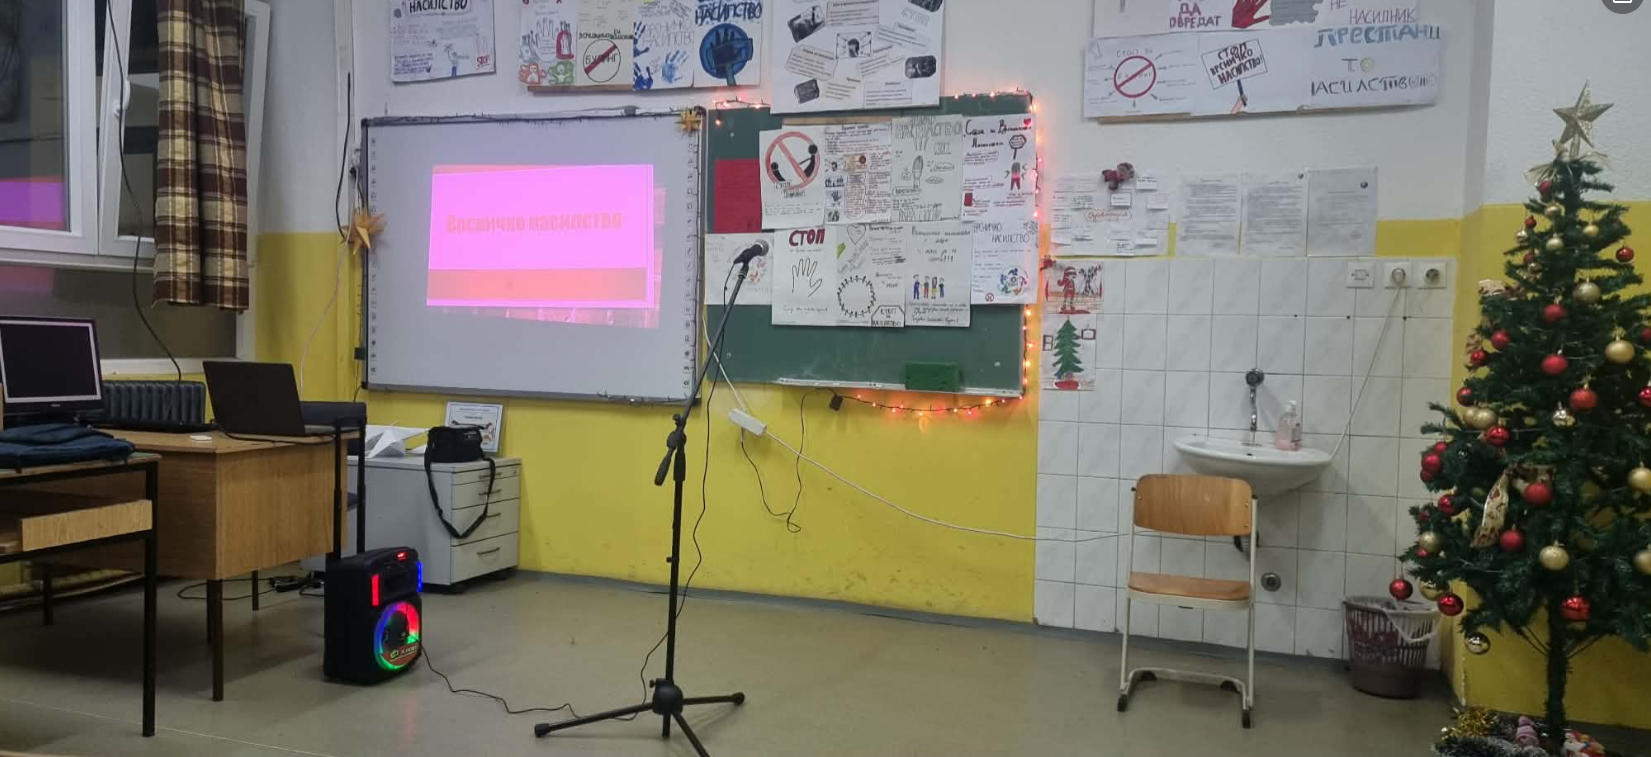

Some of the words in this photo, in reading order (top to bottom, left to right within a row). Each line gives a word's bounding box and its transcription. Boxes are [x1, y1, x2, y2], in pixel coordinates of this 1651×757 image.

[1179, 2, 1201, 16] ДА
[1350, 8, 1416, 24] НАСИЛНИК
[1217, 41, 1247, 60] СТОП
[788, 229, 826, 247] СТОП
